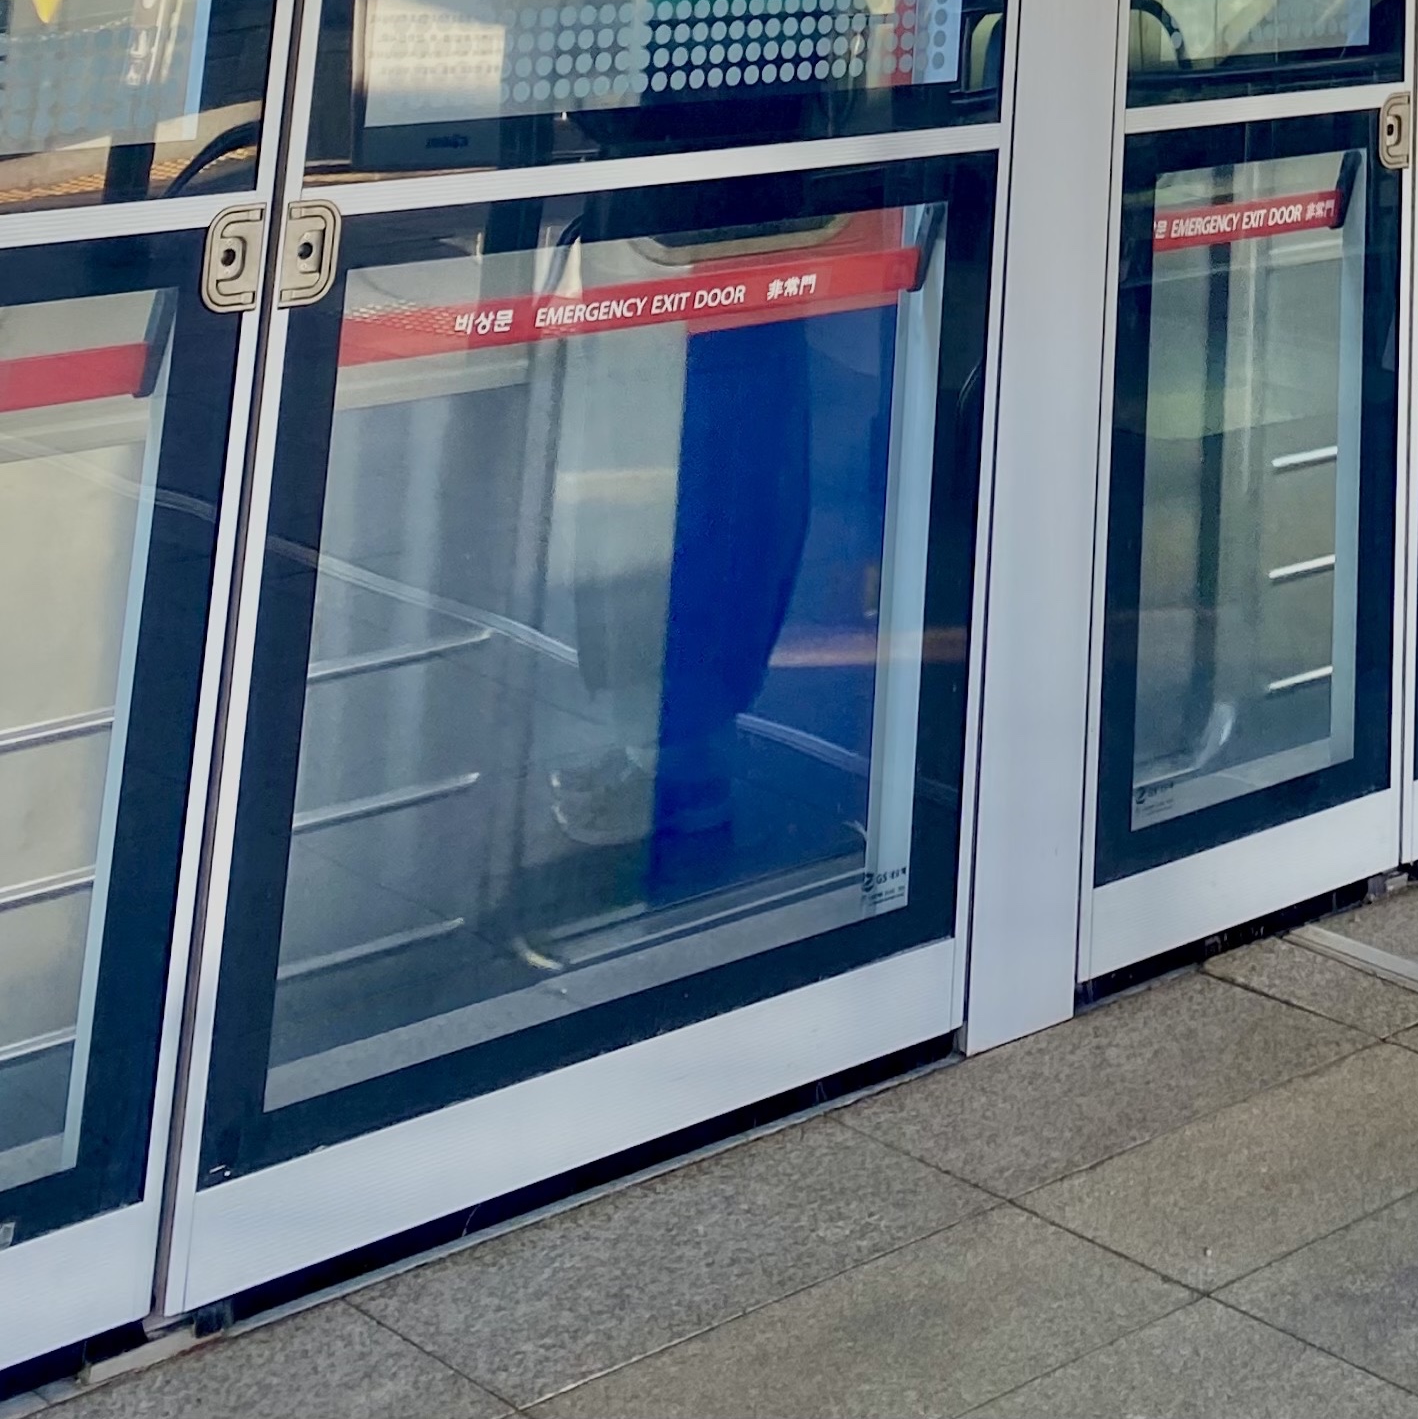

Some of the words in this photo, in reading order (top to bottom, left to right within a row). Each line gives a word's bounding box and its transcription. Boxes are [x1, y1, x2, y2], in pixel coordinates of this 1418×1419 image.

[1170, 211, 1241, 238] EMERGENCY
[1241, 209, 1267, 230] EXIT
[1268, 203, 1303, 225] DOOR
[453, 309, 513, 335] 비상문
[534, 296, 650, 329] EMERGENCY
[650, 290, 691, 314] EXIT
[693, 284, 747, 310] DOOR
[766, 273, 817, 302] 非常門
